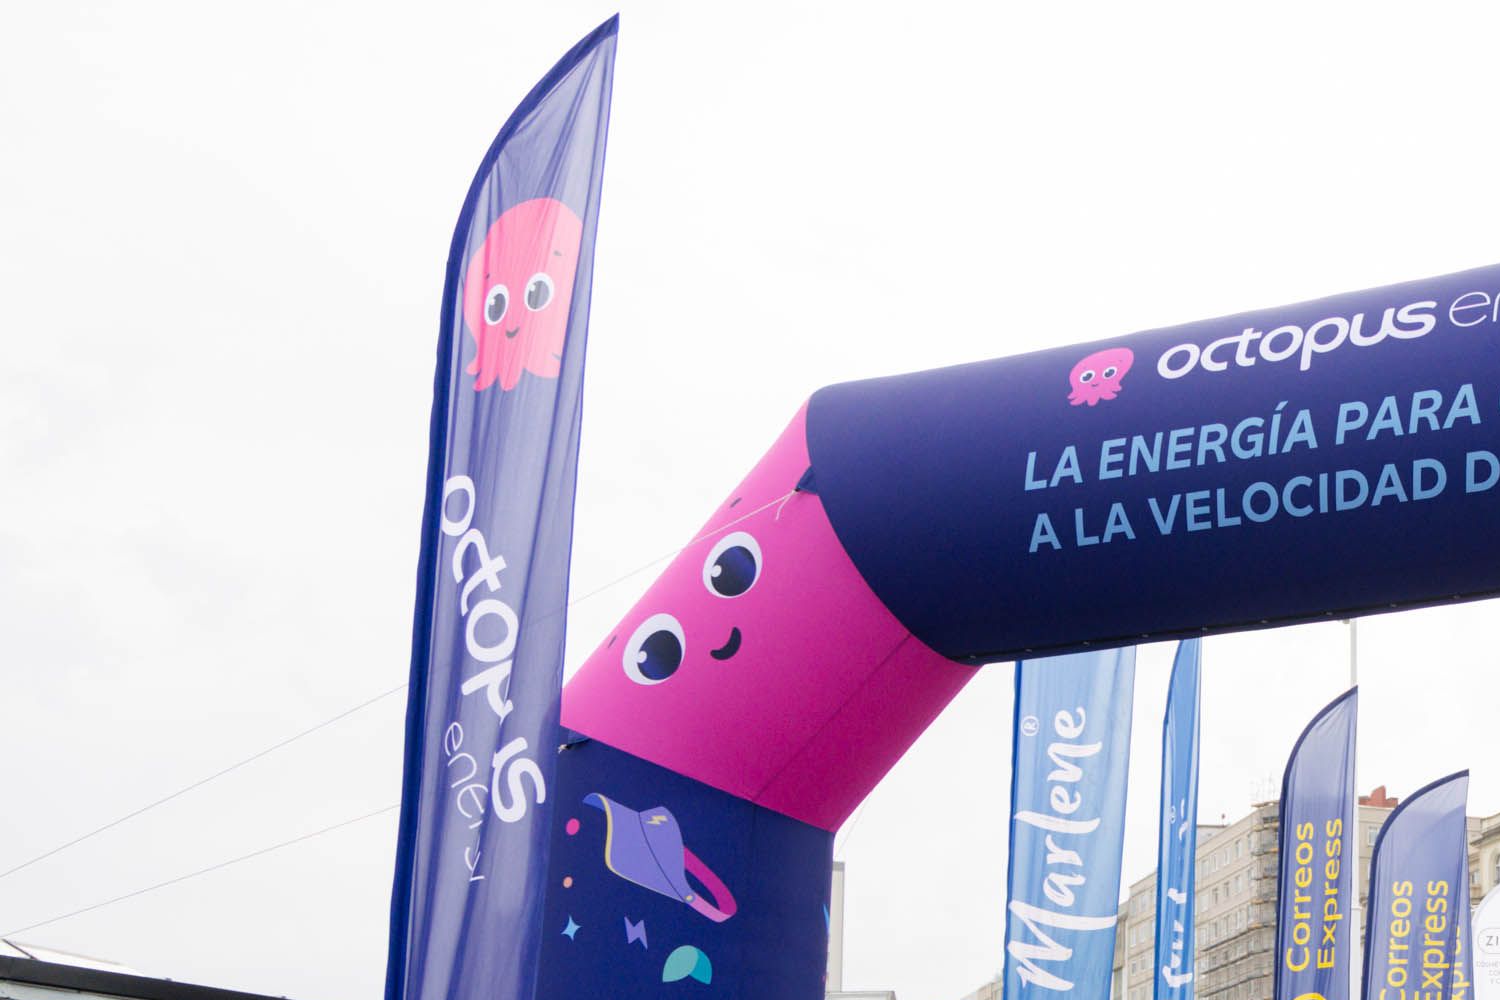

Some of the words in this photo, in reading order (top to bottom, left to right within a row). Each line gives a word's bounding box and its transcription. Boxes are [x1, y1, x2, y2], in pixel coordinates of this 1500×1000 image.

[1157, 300, 1437, 379] octopus
[1024, 445, 1084, 491] LA
[1099, 401, 1319, 481] ENERGÍA
[1335, 384, 1482, 447] PARA
[1029, 512, 1062, 552] A
[1076, 502, 1136, 547] LA
[1148, 457, 1448, 536] VELOCIDAD
[1007, 706, 1118, 991] Marlene
[1286, 822, 1315, 972] Correos
[1317, 818, 1343, 969] Express
